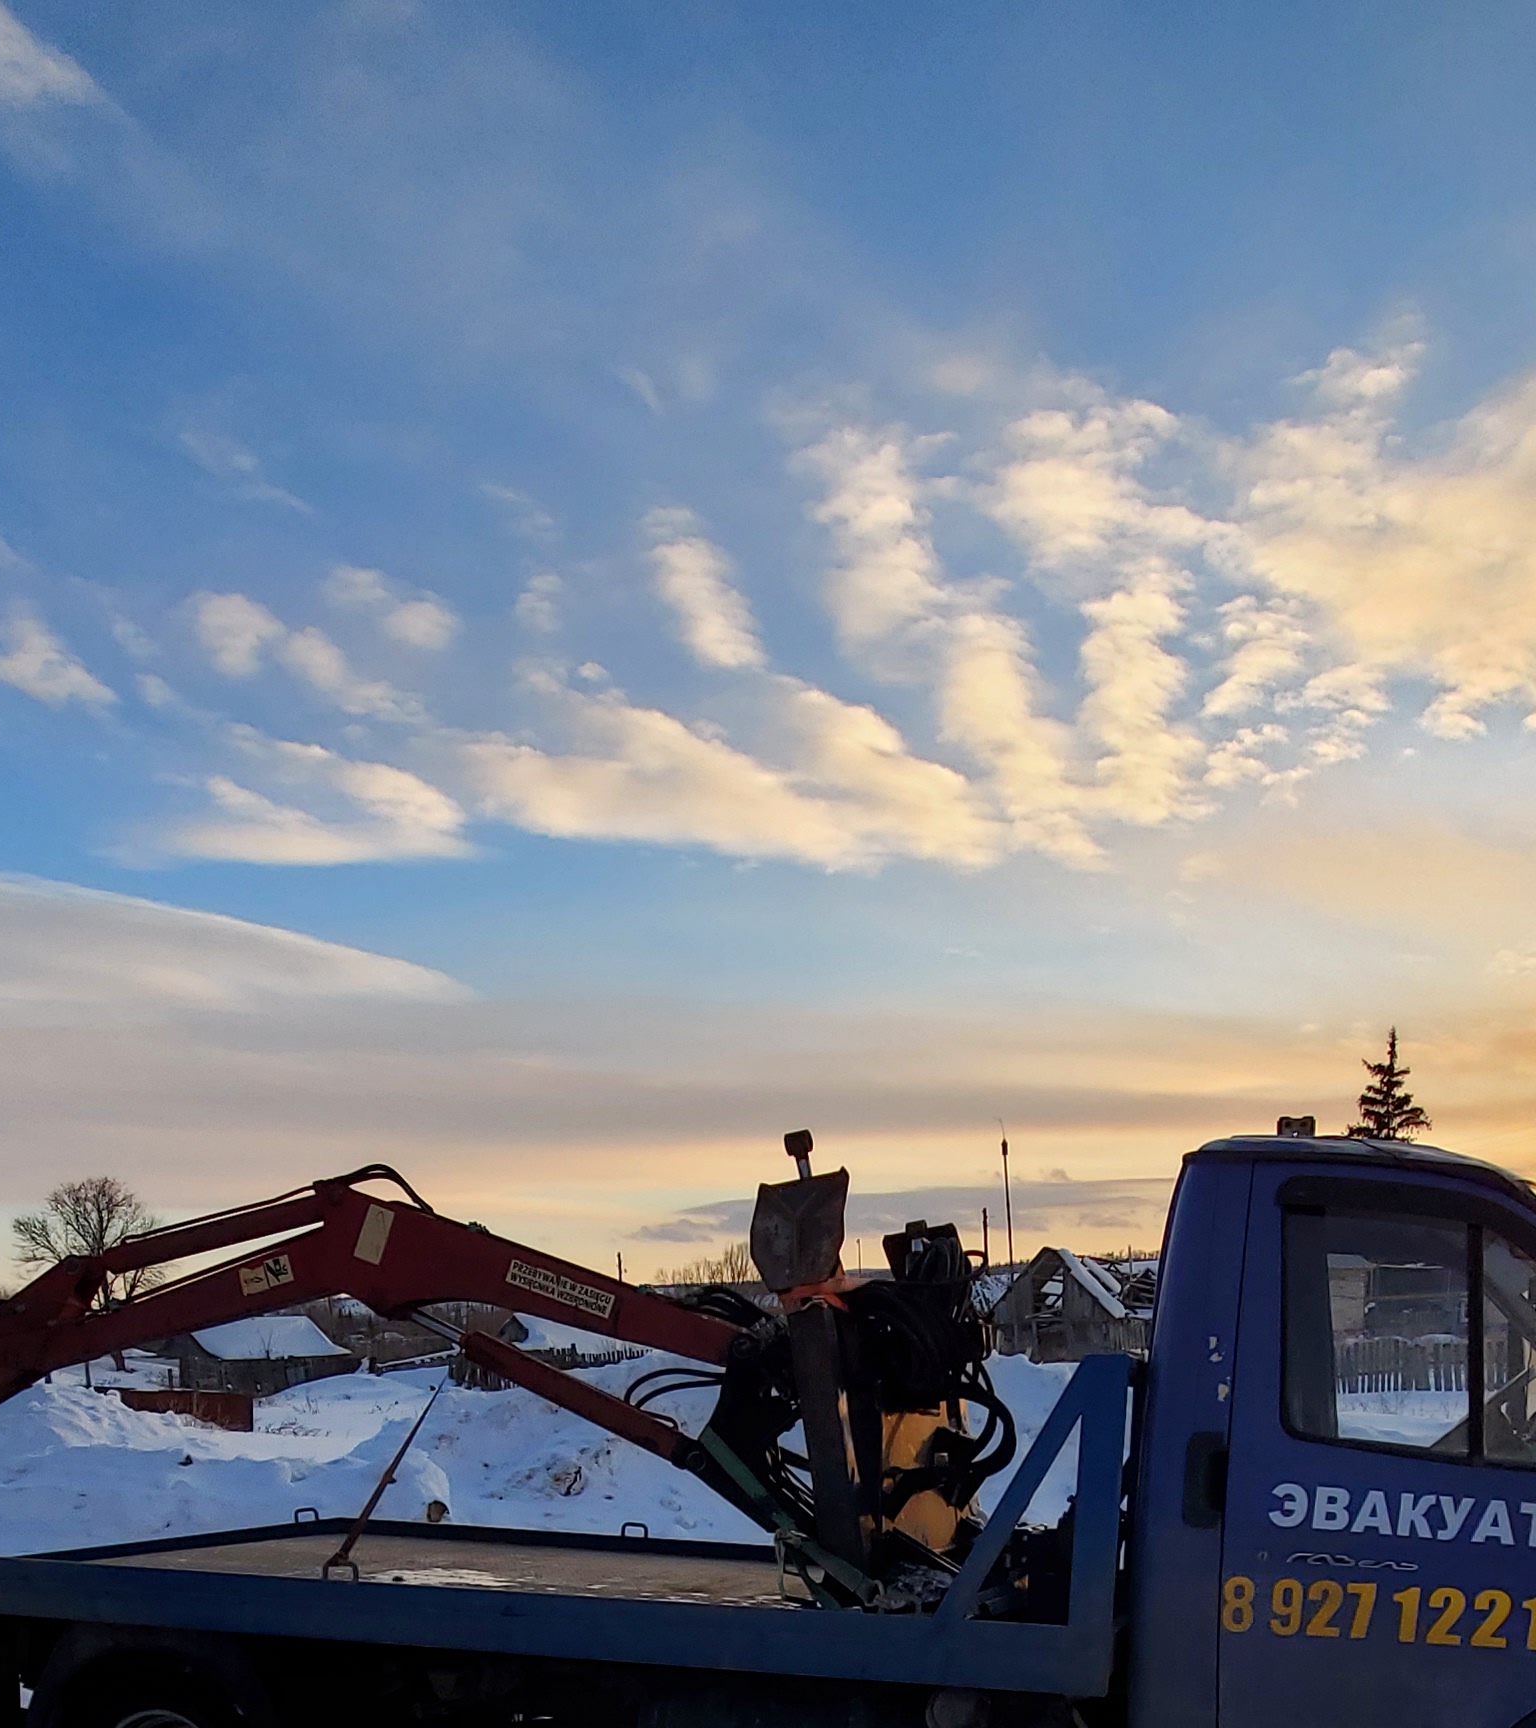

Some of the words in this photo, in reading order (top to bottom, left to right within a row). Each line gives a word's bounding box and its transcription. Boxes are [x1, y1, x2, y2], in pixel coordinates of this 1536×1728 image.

[569, 1281, 577, 1292] W
[1223, 1576, 1255, 1633] 8
[1270, 1578, 1378, 1640] 927
